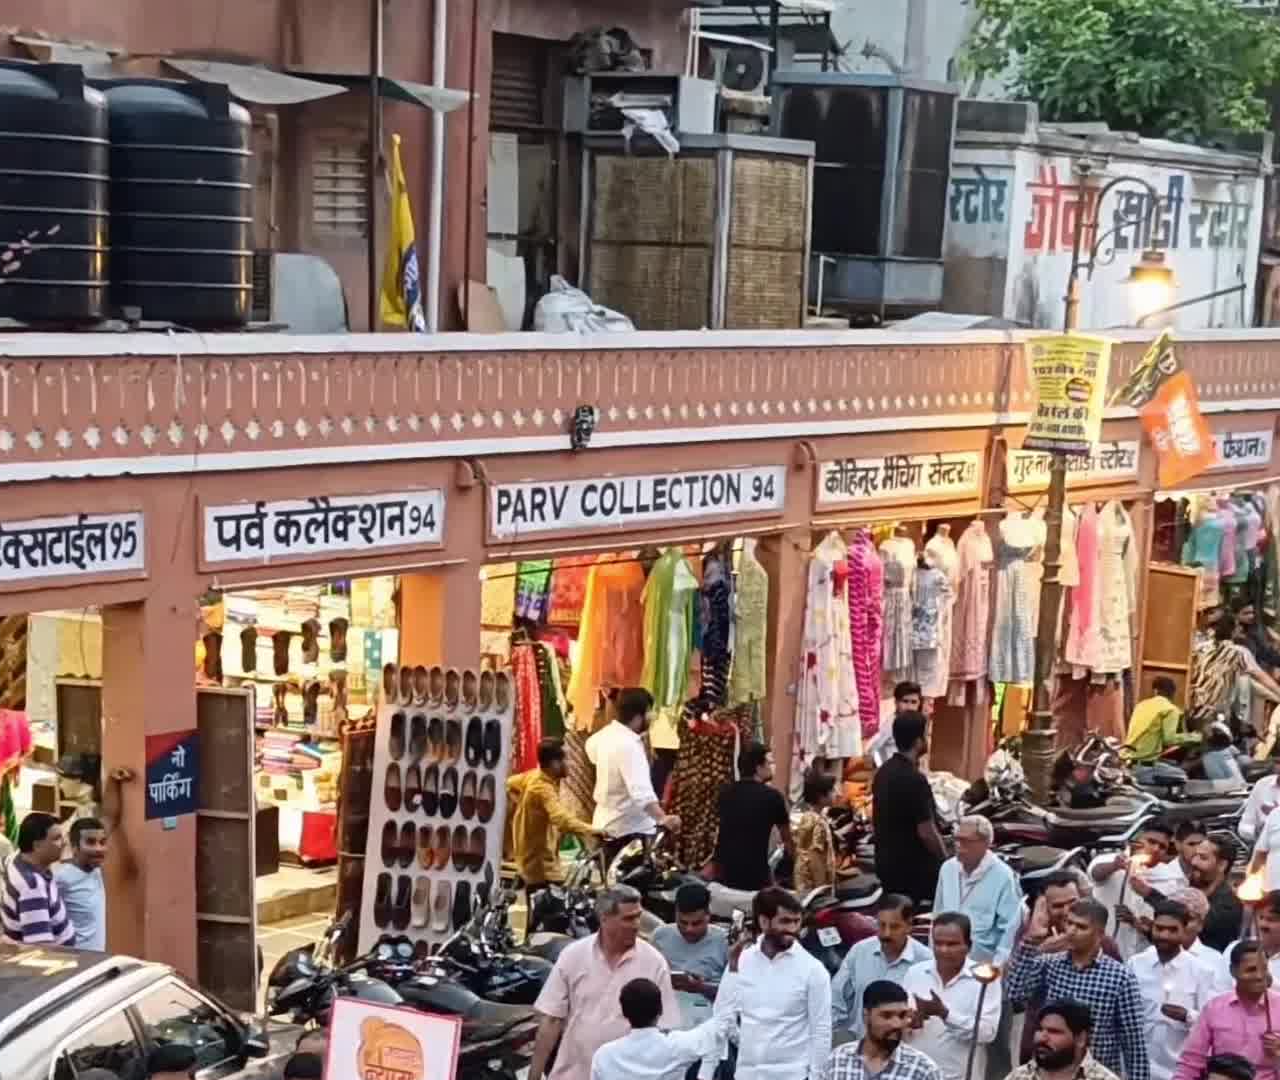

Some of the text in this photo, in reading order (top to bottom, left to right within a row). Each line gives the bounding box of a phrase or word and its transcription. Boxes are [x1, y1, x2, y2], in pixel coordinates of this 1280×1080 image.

[950, 164, 1008, 224] स्टोर
[497, 473, 775, 525] PARV COLLECTION 94
[110, 521, 137, 561] 95
[213, 501, 268, 551] पर्व
[409, 503, 436, 535] 94
[171, 744, 185, 768] नो
[148, 772, 192, 804] पार्किंग
